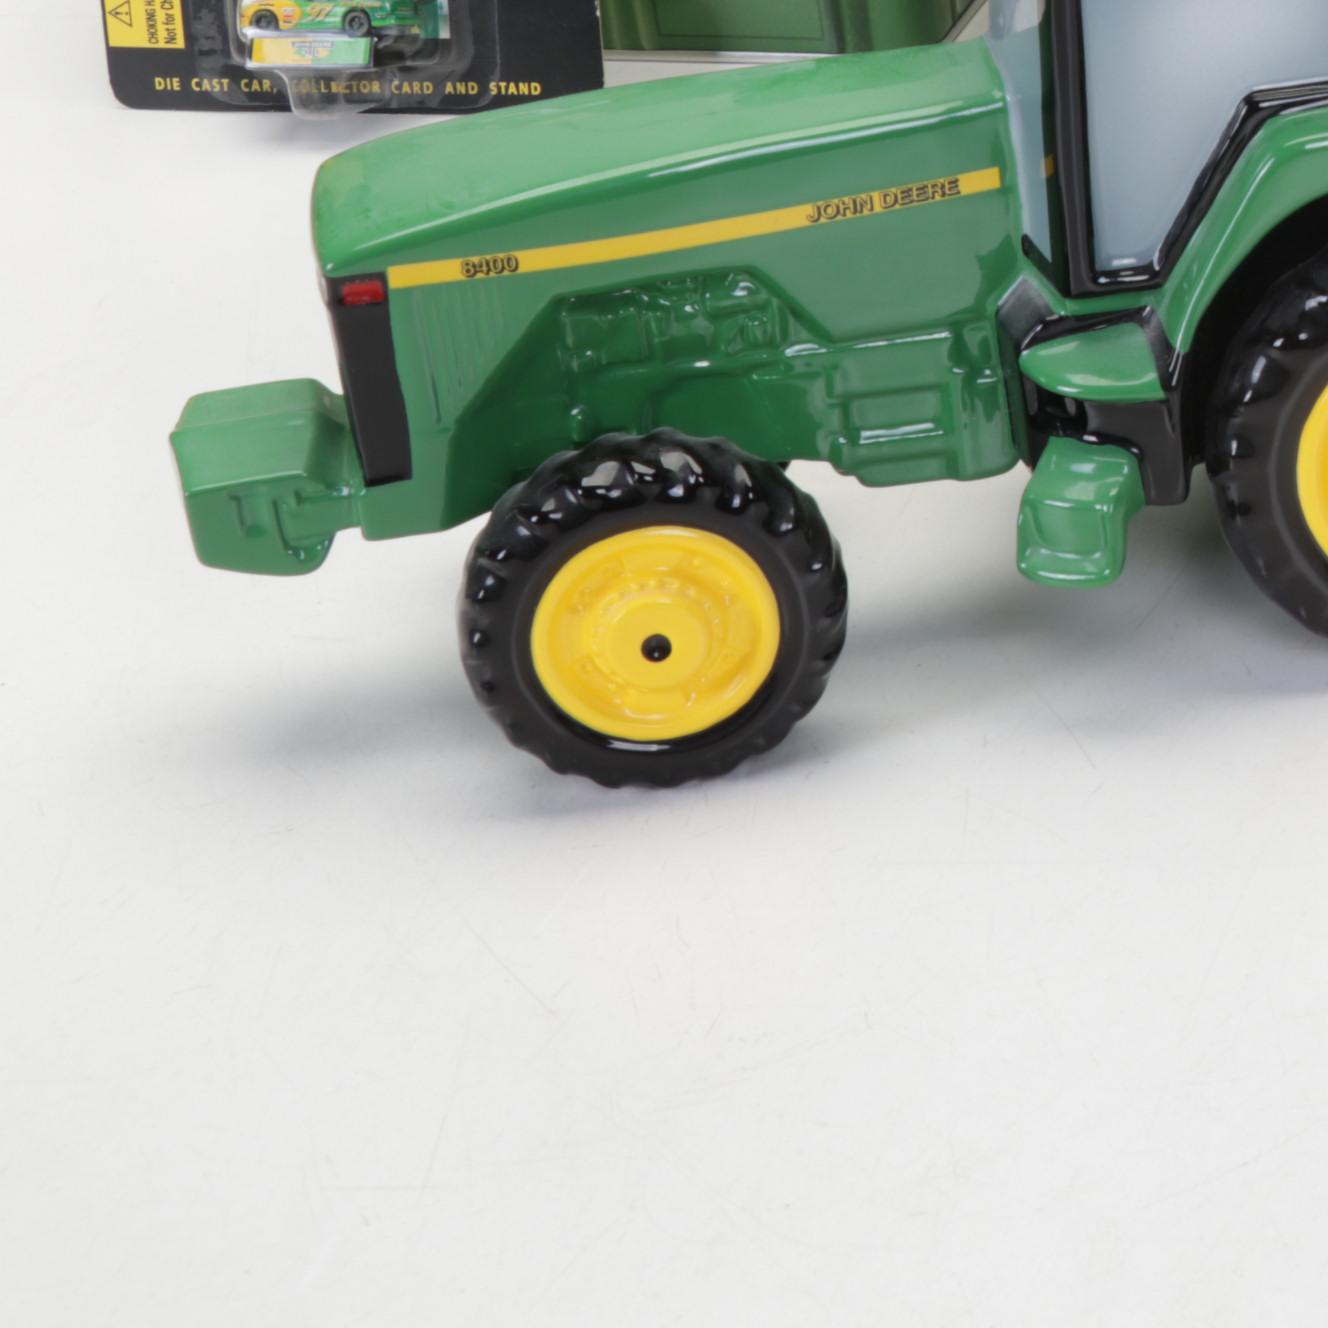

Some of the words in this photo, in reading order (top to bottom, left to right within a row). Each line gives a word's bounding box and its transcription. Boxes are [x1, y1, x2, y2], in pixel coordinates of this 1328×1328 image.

[145, 9, 159, 44] CHOKING
[164, 12, 177, 25] for
[164, 27, 177, 45] Not
[154, 76, 182, 92] DIE
[191, 77, 231, 93] CAST
[240, 78, 278, 95] CAR,
[291, 79, 382, 95] COLLECTOR
[390, 79, 434, 95] CARD
[444, 80, 479, 95] AND
[488, 81, 543, 97] STAND
[805, 191, 875, 225] JOHN
[879, 177, 961, 212] DEERE
[460, 253, 519, 278] 8400
